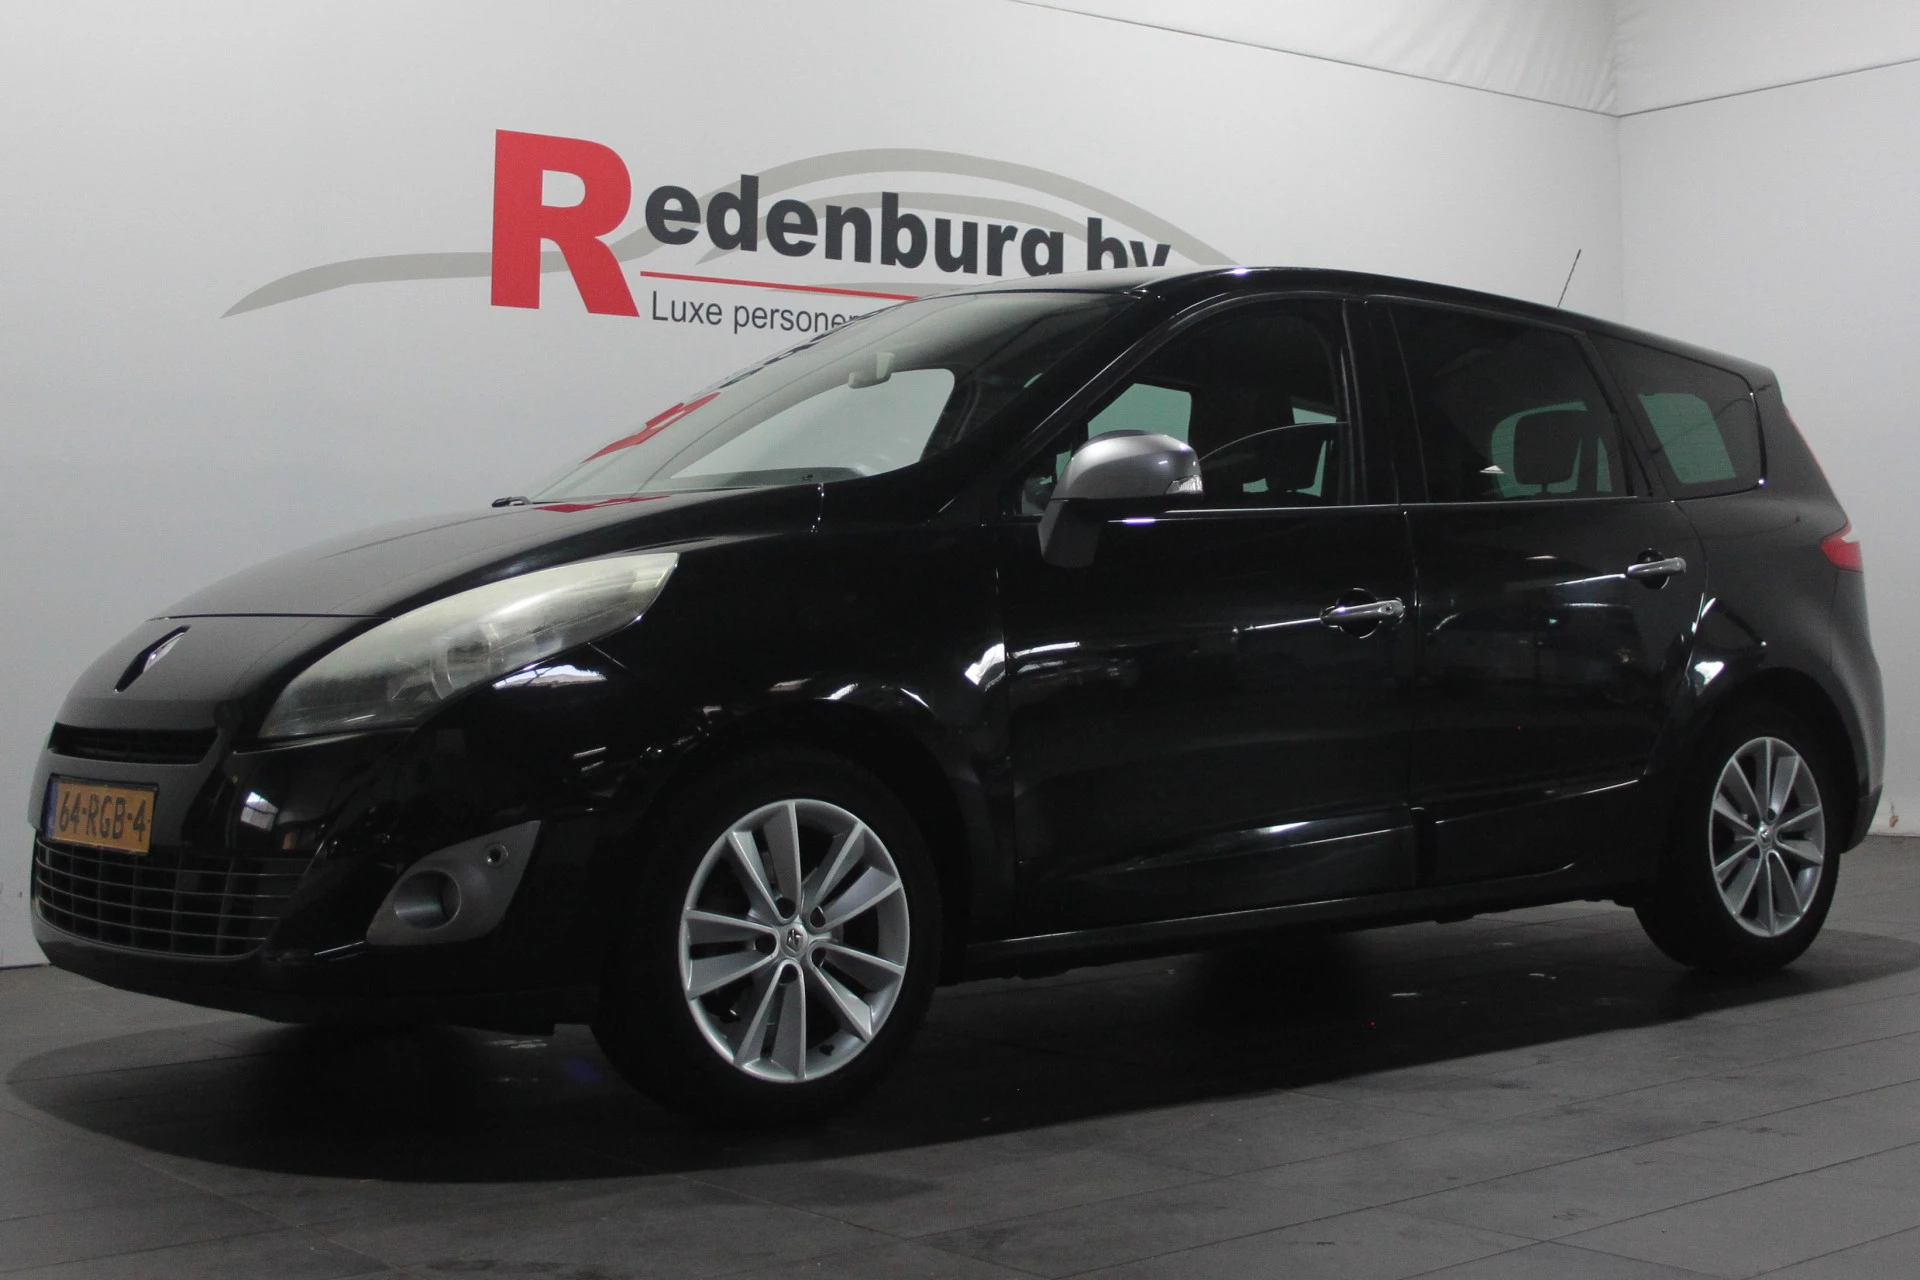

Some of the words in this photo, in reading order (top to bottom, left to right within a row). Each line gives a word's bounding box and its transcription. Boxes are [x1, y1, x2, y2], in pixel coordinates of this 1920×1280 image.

[652, 290, 722, 325] Luxe
[733, 305, 859, 334] persone
[58, 791, 147, 842] 64-RGB-4
